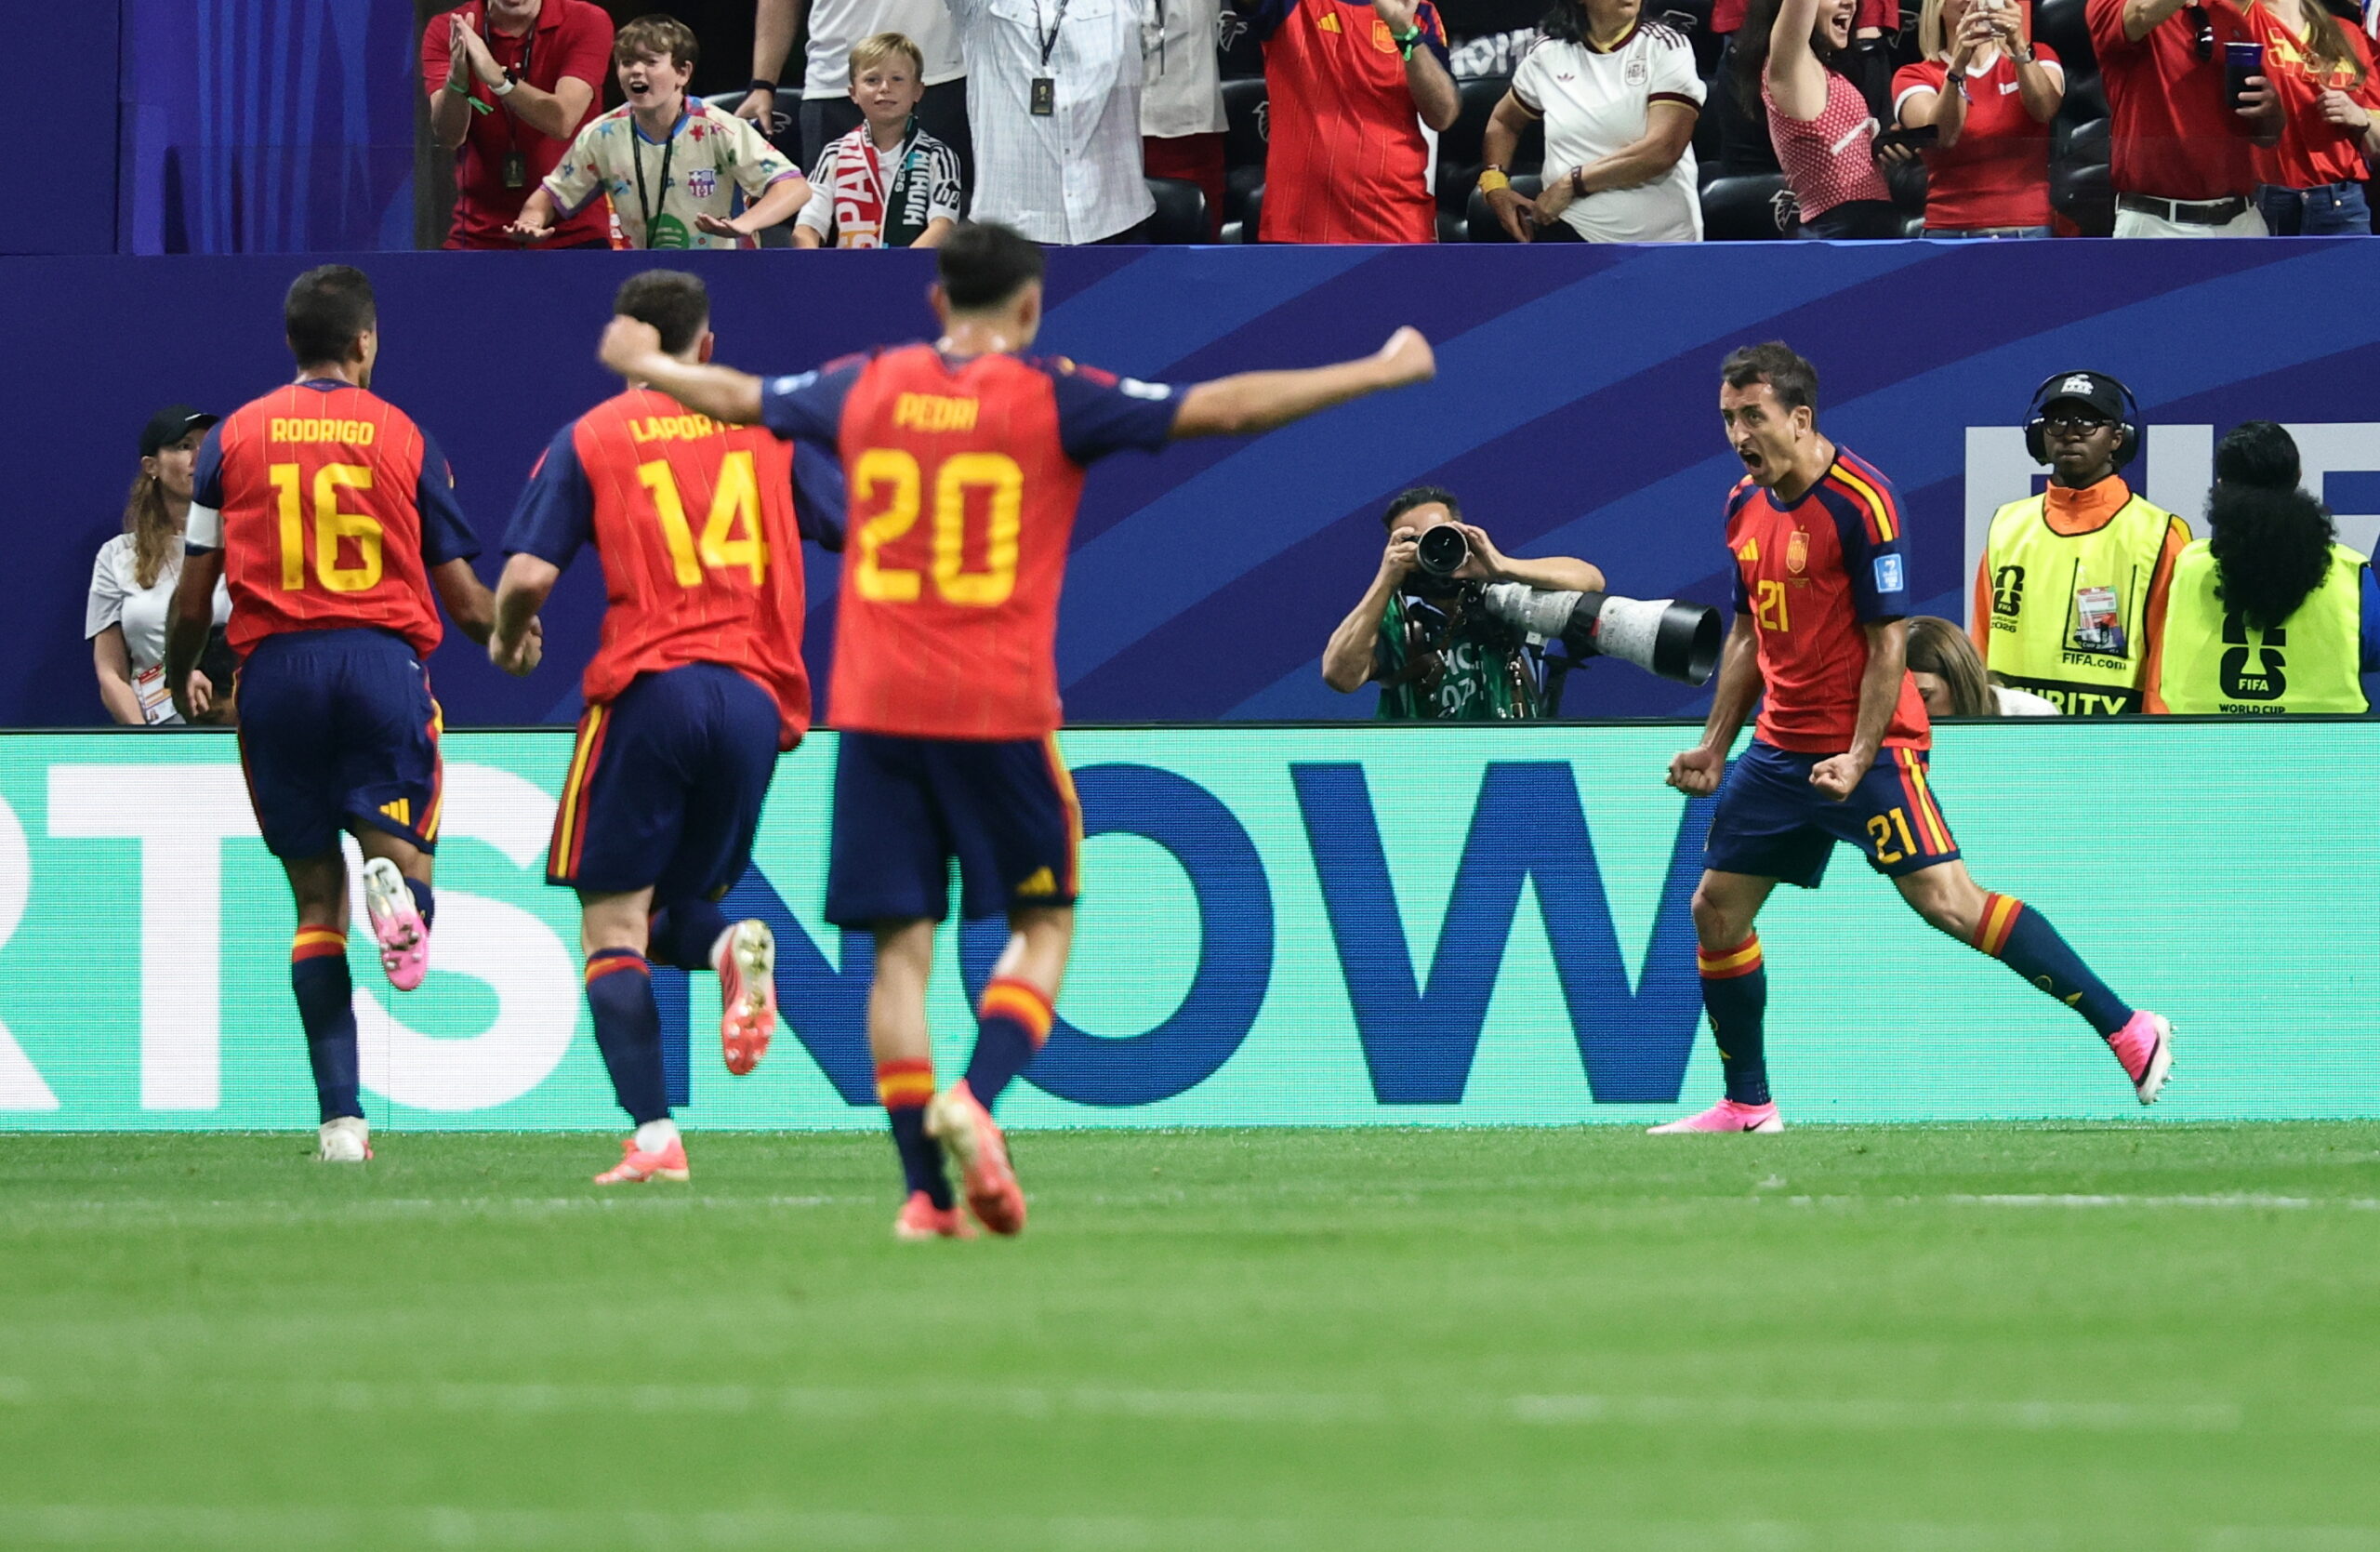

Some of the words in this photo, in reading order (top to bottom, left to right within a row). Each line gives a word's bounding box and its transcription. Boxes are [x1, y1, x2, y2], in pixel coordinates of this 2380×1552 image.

[271, 418, 376, 446] RODRIGO
[629, 413, 744, 443] LAPOR
[893, 391, 979, 432] PEDRI
[269, 462, 384, 592] 16
[637, 449, 771, 588] 14
[855, 447, 1025, 608] 20
[1758, 579, 1789, 632] 21
[2062, 652, 2126, 670] FIFA.com
[2238, 679, 2269, 692] FIFA
[2218, 704, 2261, 714] WORLD
[2262, 705, 2286, 714] CUP
[1867, 807, 1917, 864] 21
